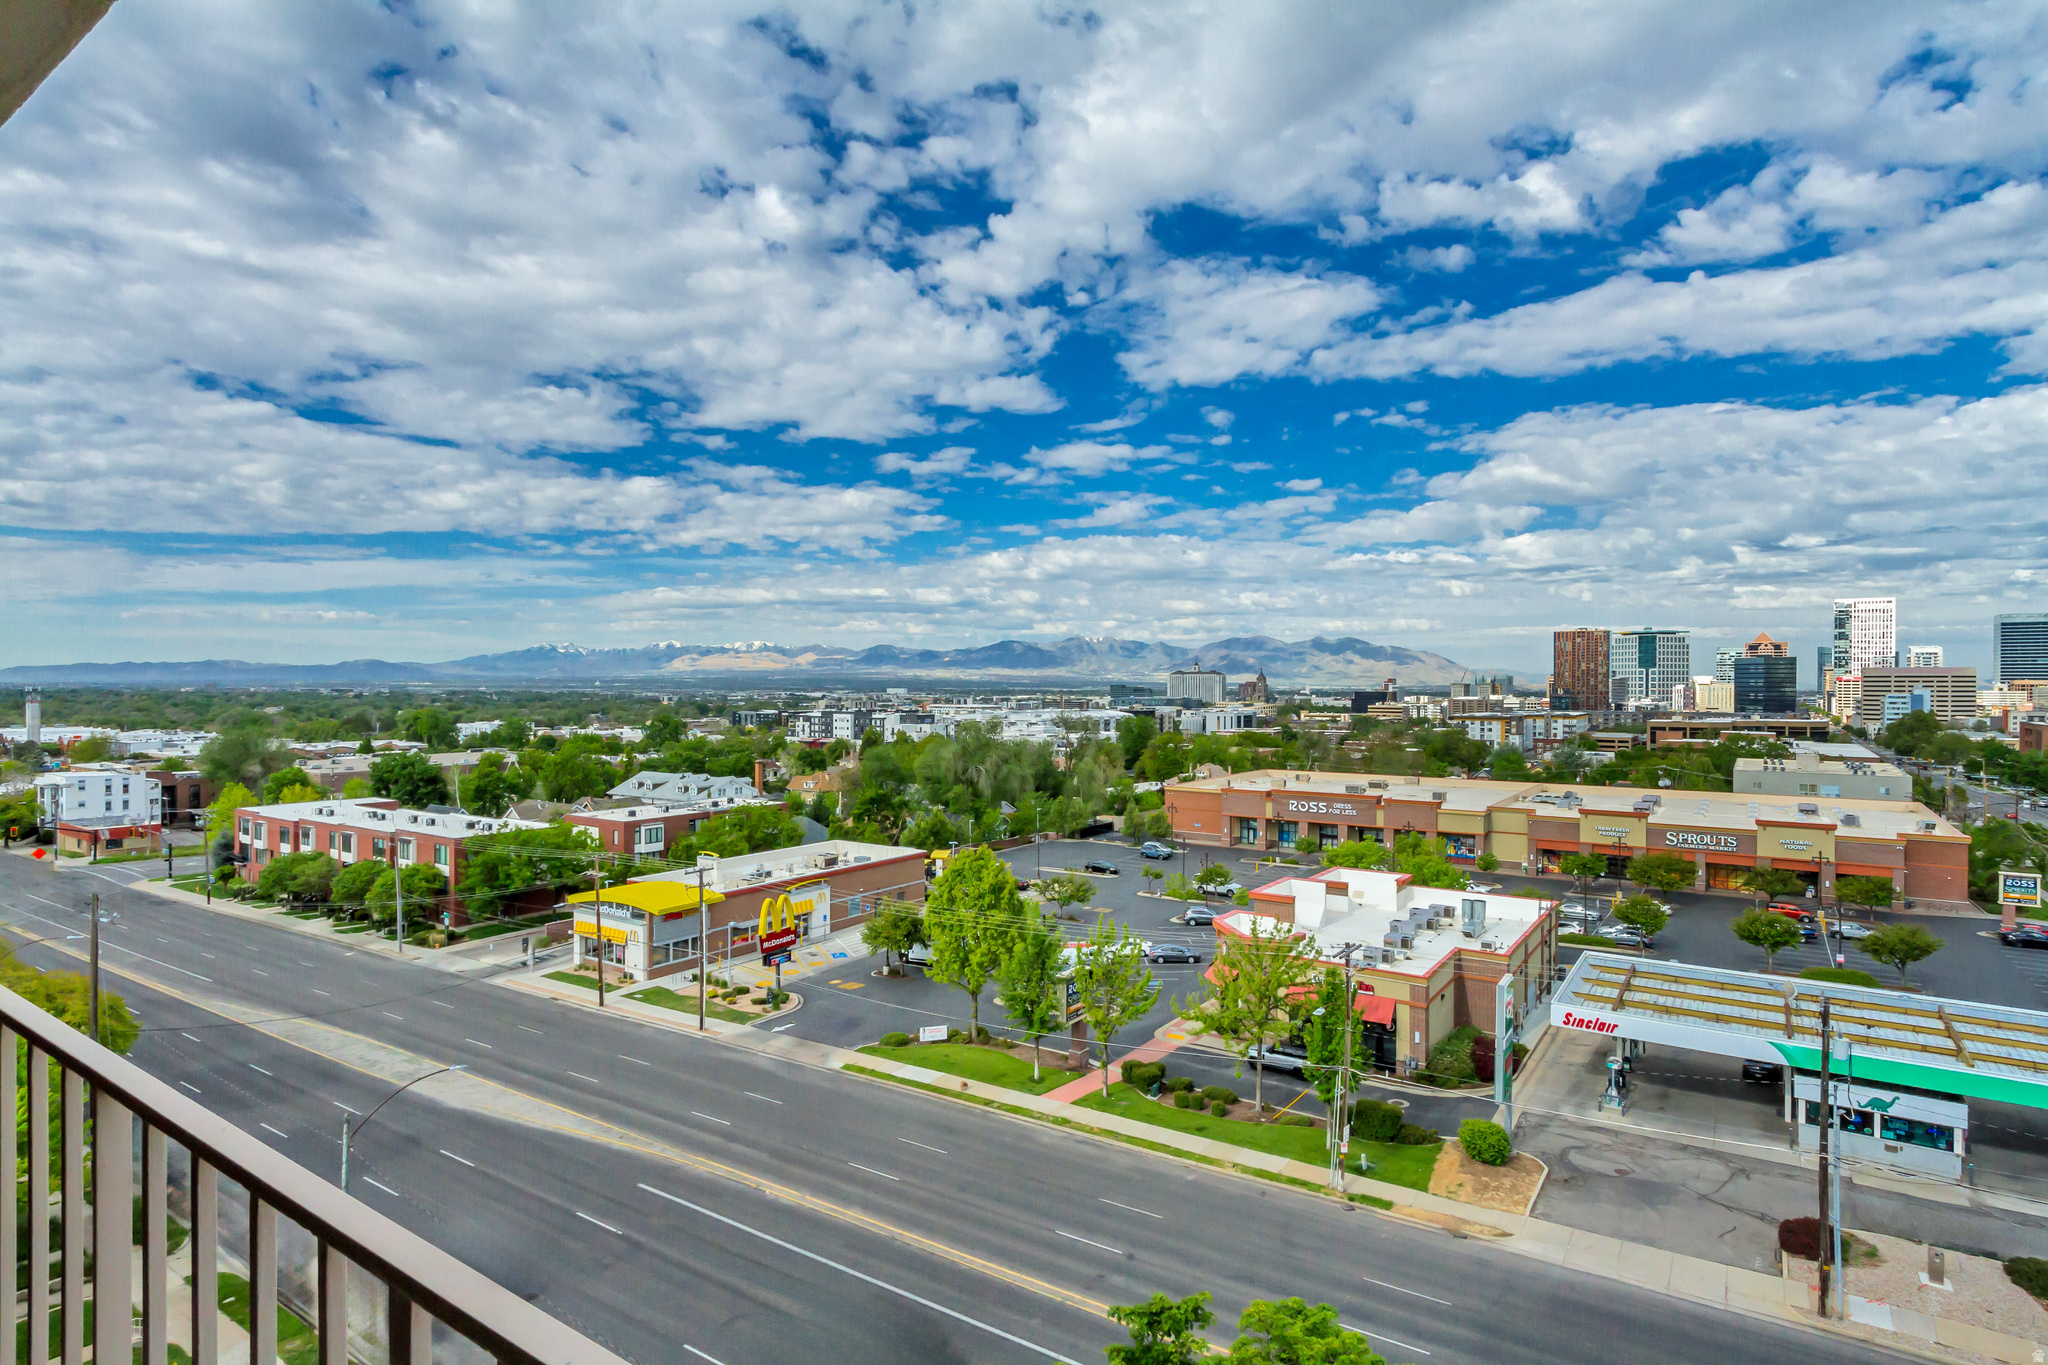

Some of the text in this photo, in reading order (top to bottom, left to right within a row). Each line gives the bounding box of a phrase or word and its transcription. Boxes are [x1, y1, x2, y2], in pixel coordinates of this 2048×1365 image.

[1289, 800, 1327, 814] ROSS
[1665, 831, 1737, 847] SPROUTS
[2005, 879, 2035, 888] ROSS
[763, 934, 796, 949] McDonald's
[1562, 1012, 1619, 1034] Sinclair
